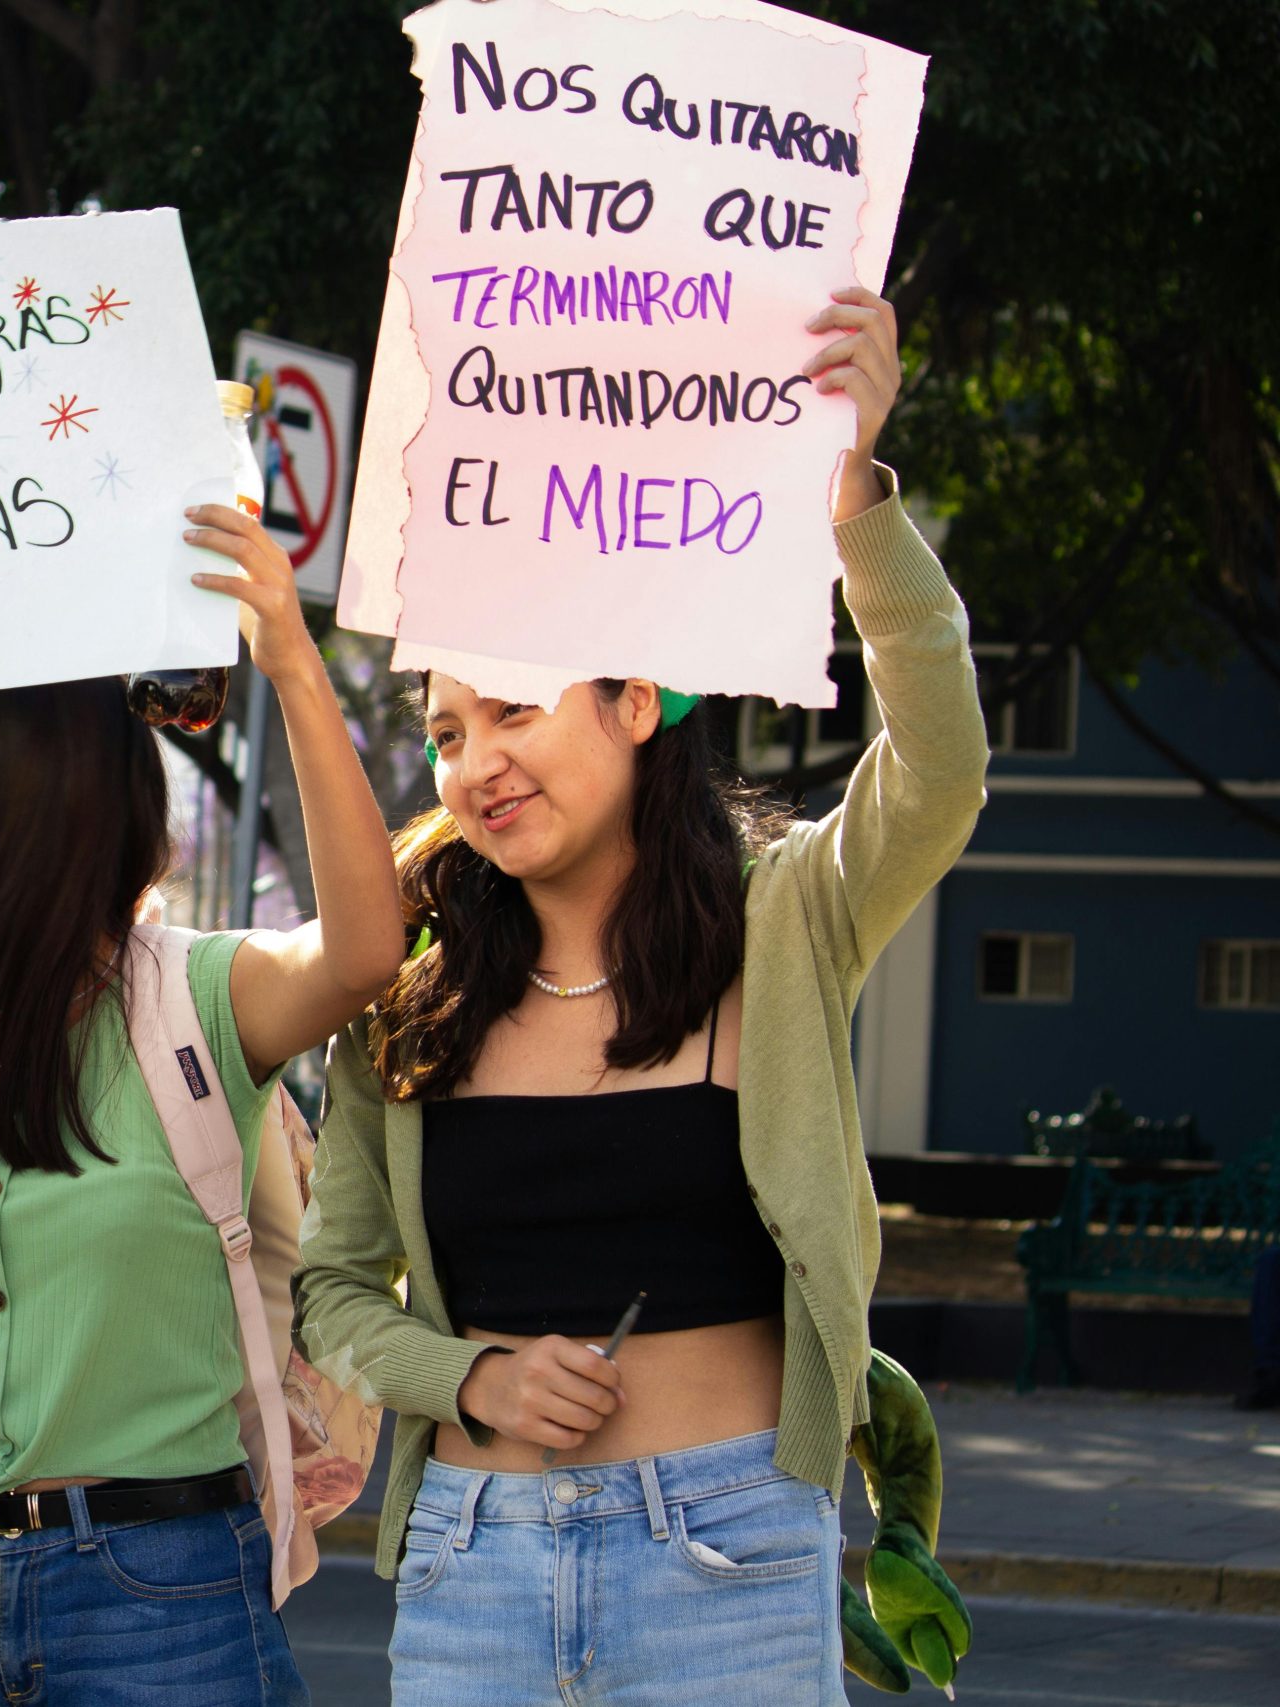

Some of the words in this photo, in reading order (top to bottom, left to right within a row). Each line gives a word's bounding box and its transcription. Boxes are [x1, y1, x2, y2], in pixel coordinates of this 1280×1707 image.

[451, 40, 597, 115] NOS
[622, 72, 860, 178] QUITARON
[440, 164, 655, 238] TANTO
[703, 188, 832, 251] QUE
[431, 264, 732, 328] TERMINARON
[447, 345, 813, 429] QUITANDONOS
[444, 457, 511, 527] EL
[537, 463, 764, 555] MIEDO
